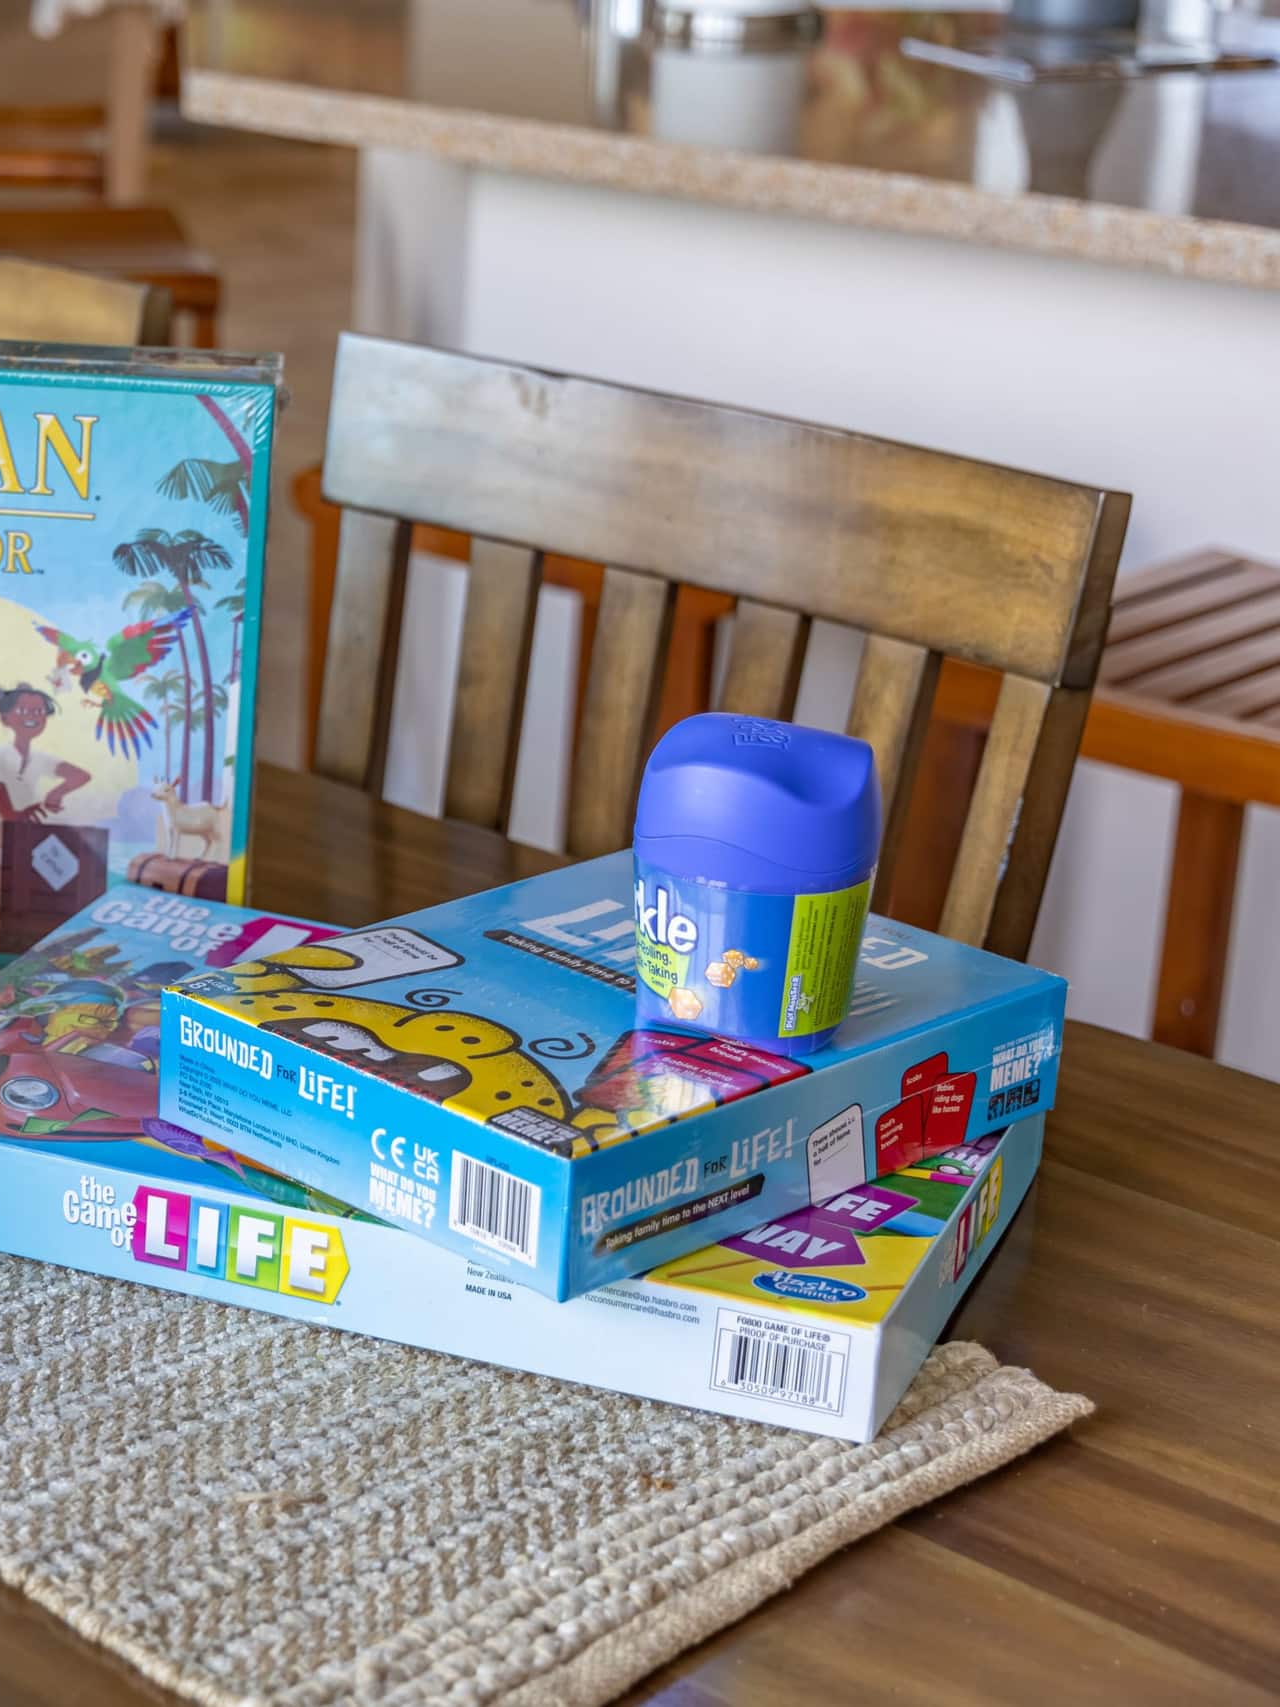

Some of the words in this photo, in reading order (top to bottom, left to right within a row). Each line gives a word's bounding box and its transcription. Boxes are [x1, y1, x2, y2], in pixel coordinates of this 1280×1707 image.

[91, 900, 244, 942] Game
[143, 895, 211, 921] the
[634, 880, 697, 953] kle
[170, 934, 223, 958] of
[503, 935, 545, 953] Taking
[544, 951, 584, 969] family
[586, 965, 615, 980] time
[179, 1014, 273, 1081] GROUNDED
[990, 1052, 1041, 1092] MEME?
[413, 1142, 440, 1168] UK
[413, 1160, 440, 1184] CA
[80, 1175, 115, 1204] the
[370, 1161, 400, 1186] WHAT
[400, 1174, 416, 1194] DO
[415, 1181, 437, 1203] YOU
[580, 1156, 700, 1237] GROUNDED
[62, 1189, 137, 1232] Game
[369, 1177, 436, 1229] MEME?
[606, 1229, 633, 1250] Taking
[633, 1218, 661, 1239] family
[662, 1212, 681, 1227] time
[682, 1208, 691, 1222] to
[692, 1202, 707, 1217] the
[707, 1193, 730, 1210] NEXT
[730, 1183, 751, 1201] level
[956, 1166, 999, 1273] LIFE
[110, 1225, 135, 1255] of
[143, 1194, 331, 1294] LIFE
[466, 1266, 484, 1278] New
[770, 1271, 858, 1297] Hasbro
[465, 1283, 486, 1296] MADE
[488, 1288, 496, 1297] IN
[497, 1290, 512, 1302] USA
[774, 1281, 839, 1303] Gaming
[740, 1326, 766, 1338] PROOF
[769, 1332, 780, 1342] OF
[782, 1335, 827, 1352] PURCHASE
[764, 1321, 789, 1334] GAME
[791, 1327, 802, 1337] OF
